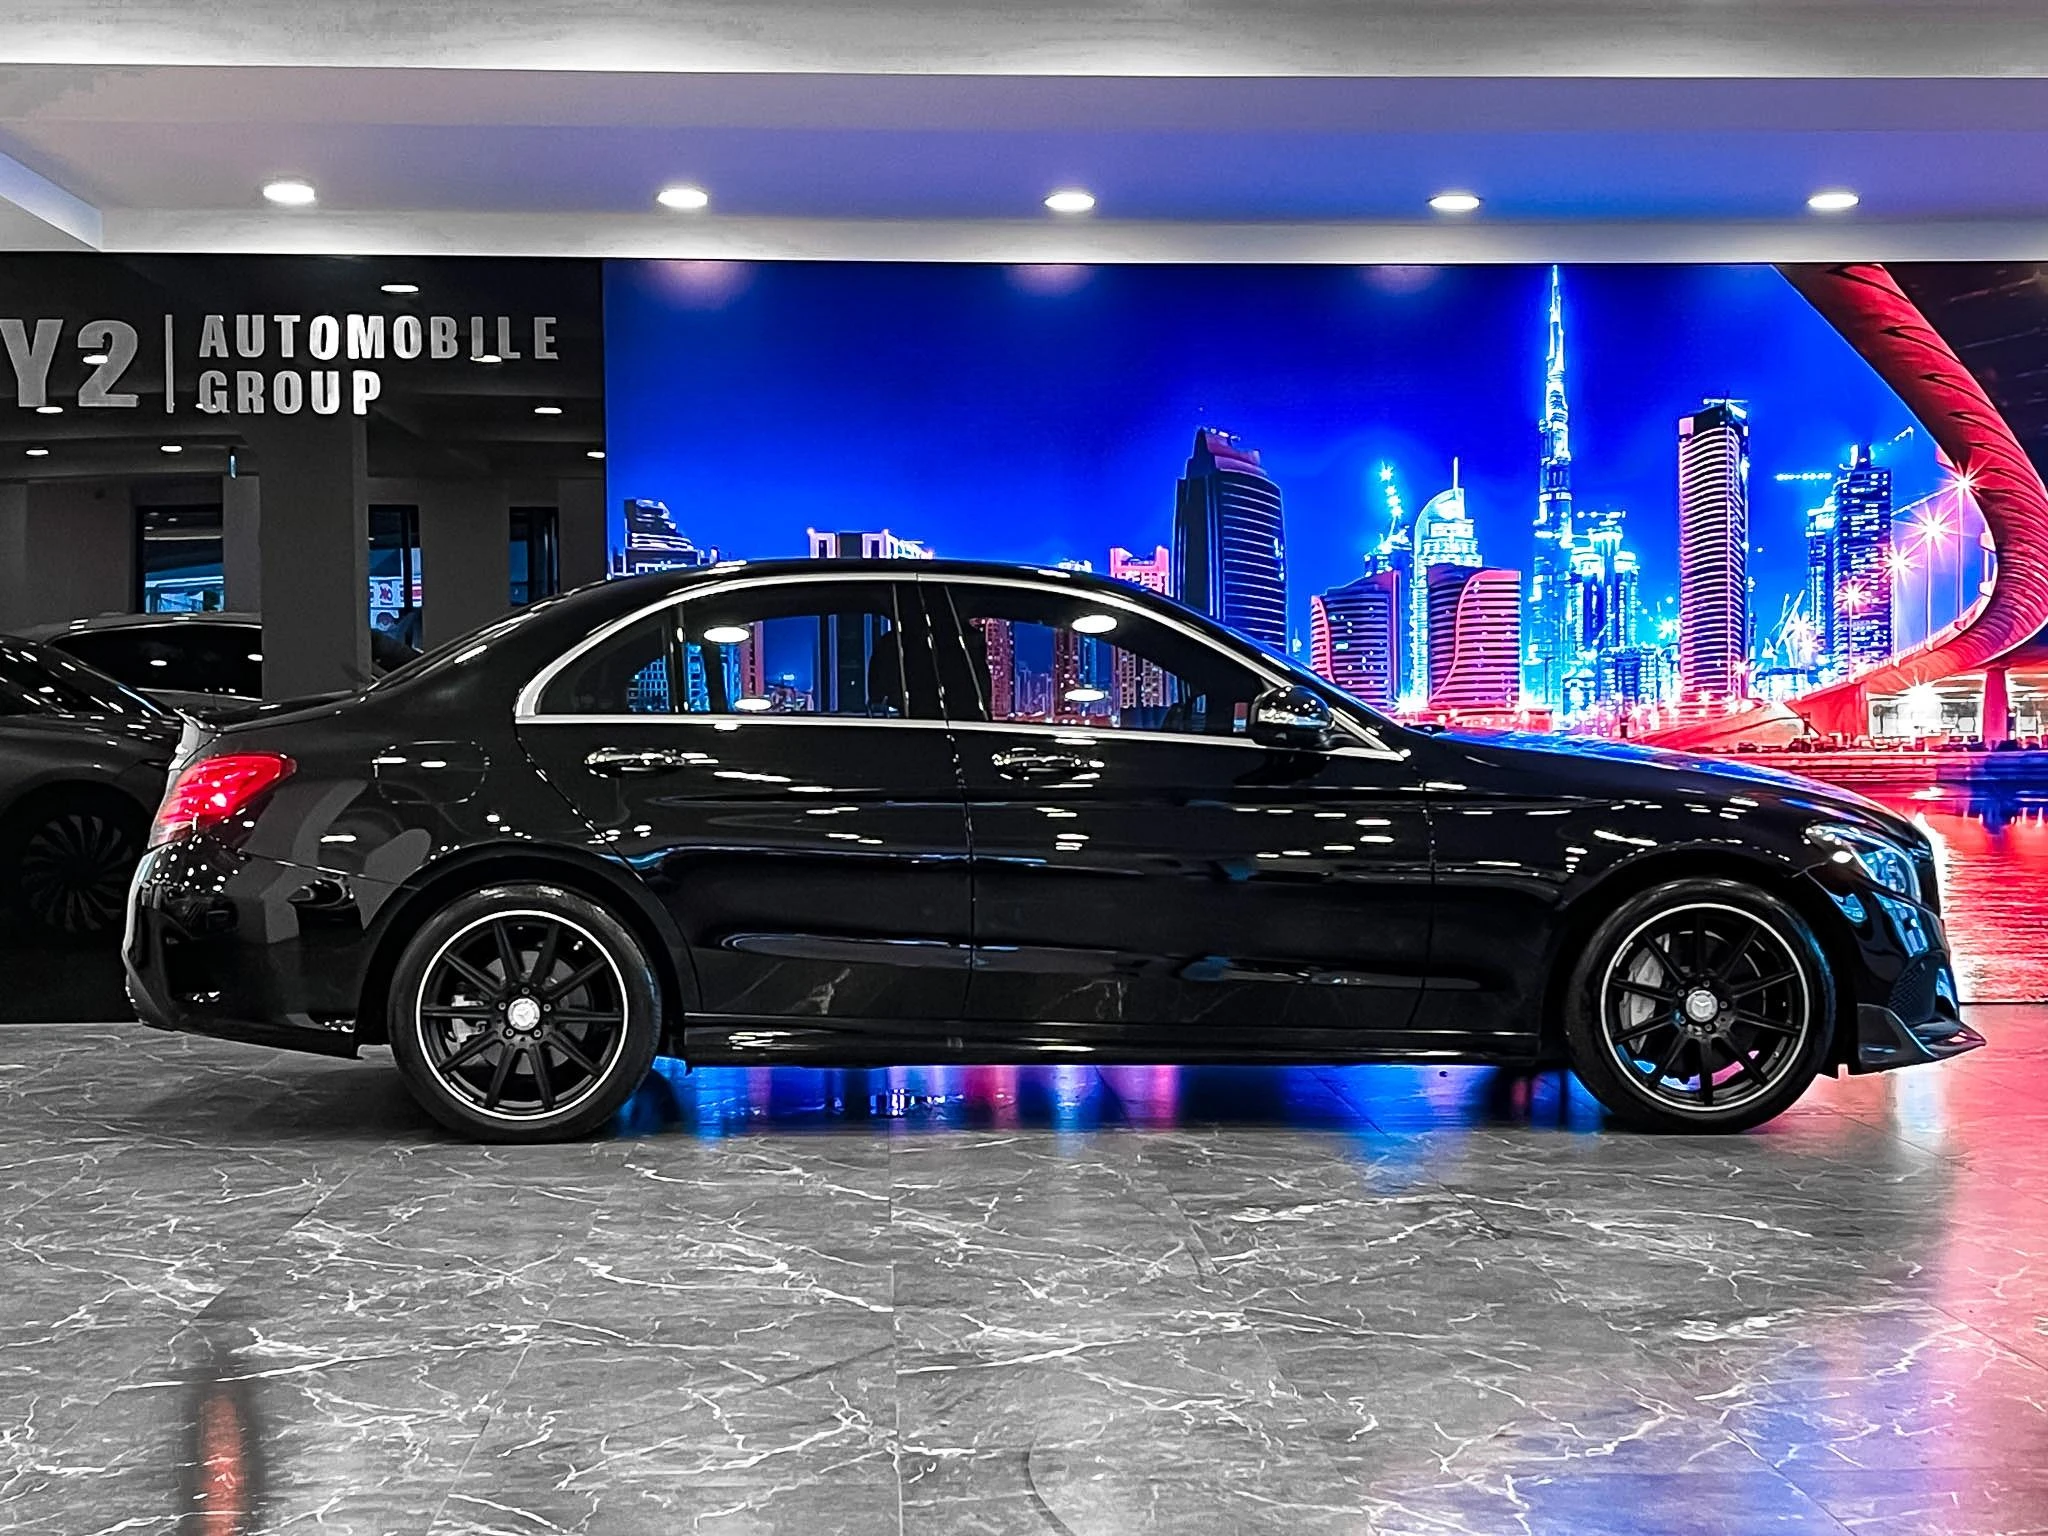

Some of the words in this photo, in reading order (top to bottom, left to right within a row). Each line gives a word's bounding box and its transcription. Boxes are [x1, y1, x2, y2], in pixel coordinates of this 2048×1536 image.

[199, 313, 560, 361] AUTOMOBILE
[0, 319, 139, 408] Y2
[198, 369, 382, 415] GROUP
